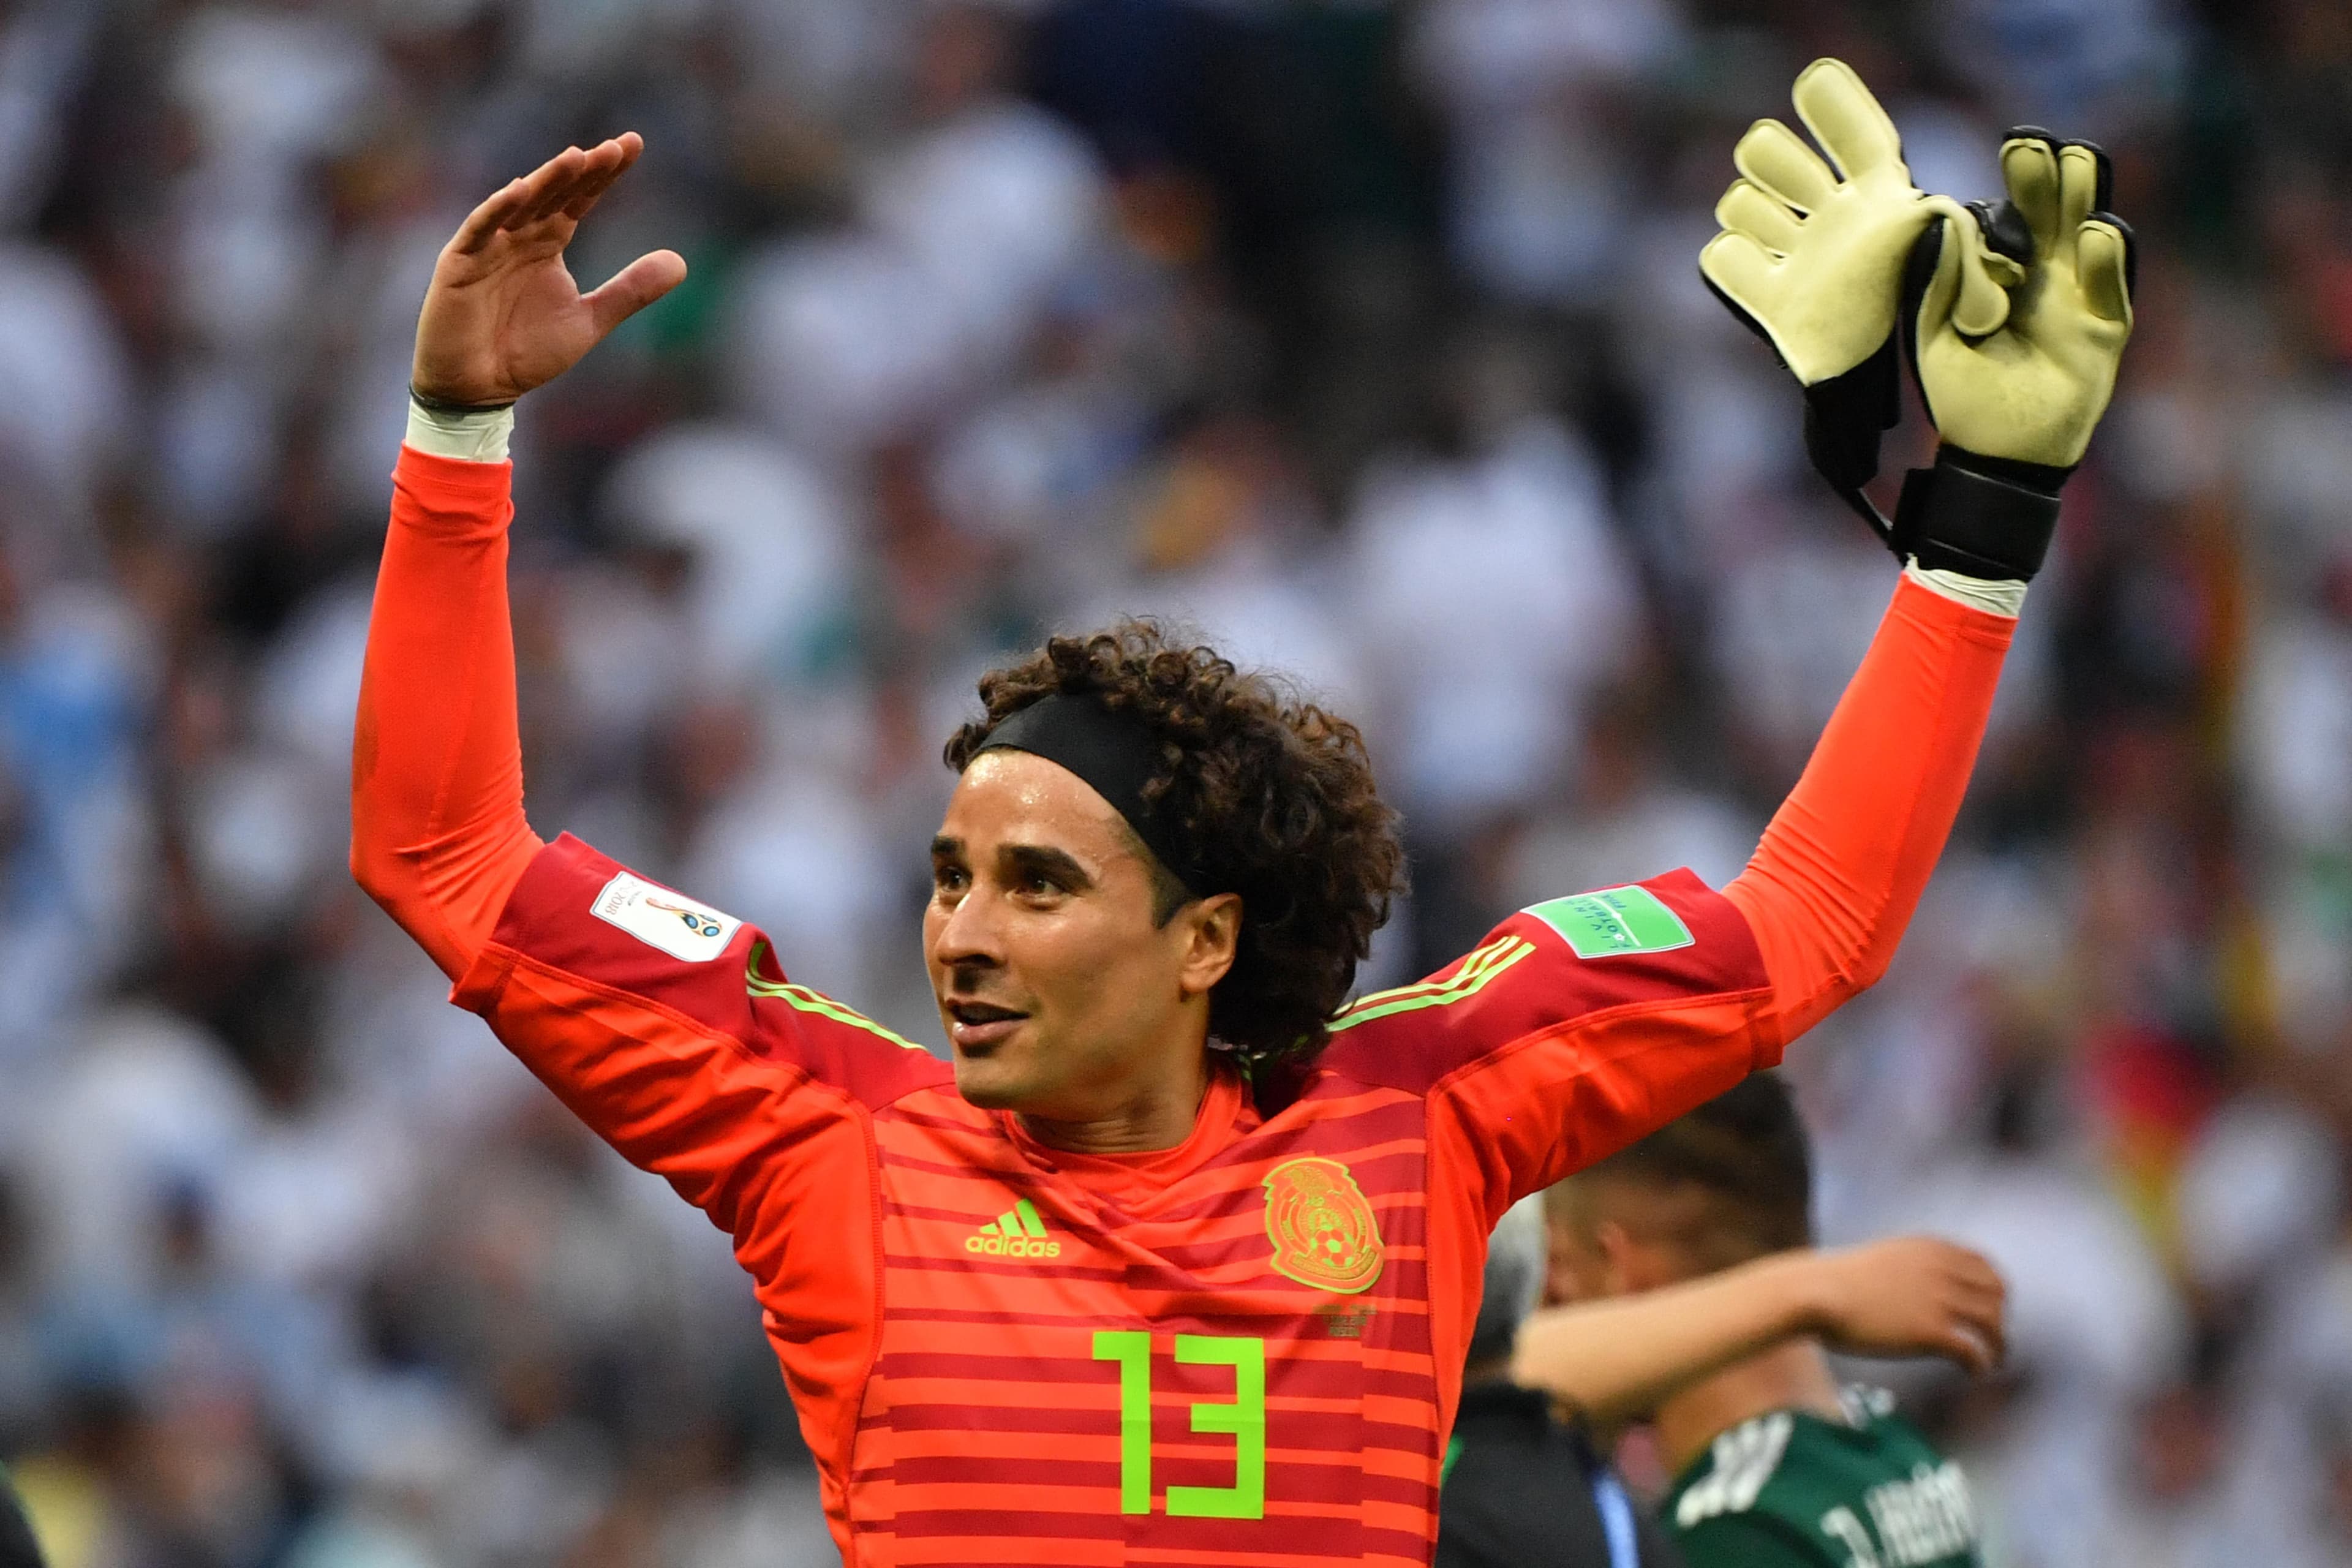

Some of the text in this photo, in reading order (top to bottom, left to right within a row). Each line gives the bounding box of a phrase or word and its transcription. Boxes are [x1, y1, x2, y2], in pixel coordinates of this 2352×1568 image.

[605, 892, 627, 915] 2018
[965, 1235, 1061, 1257] adidas
[1093, 1331, 1265, 1520] 13
